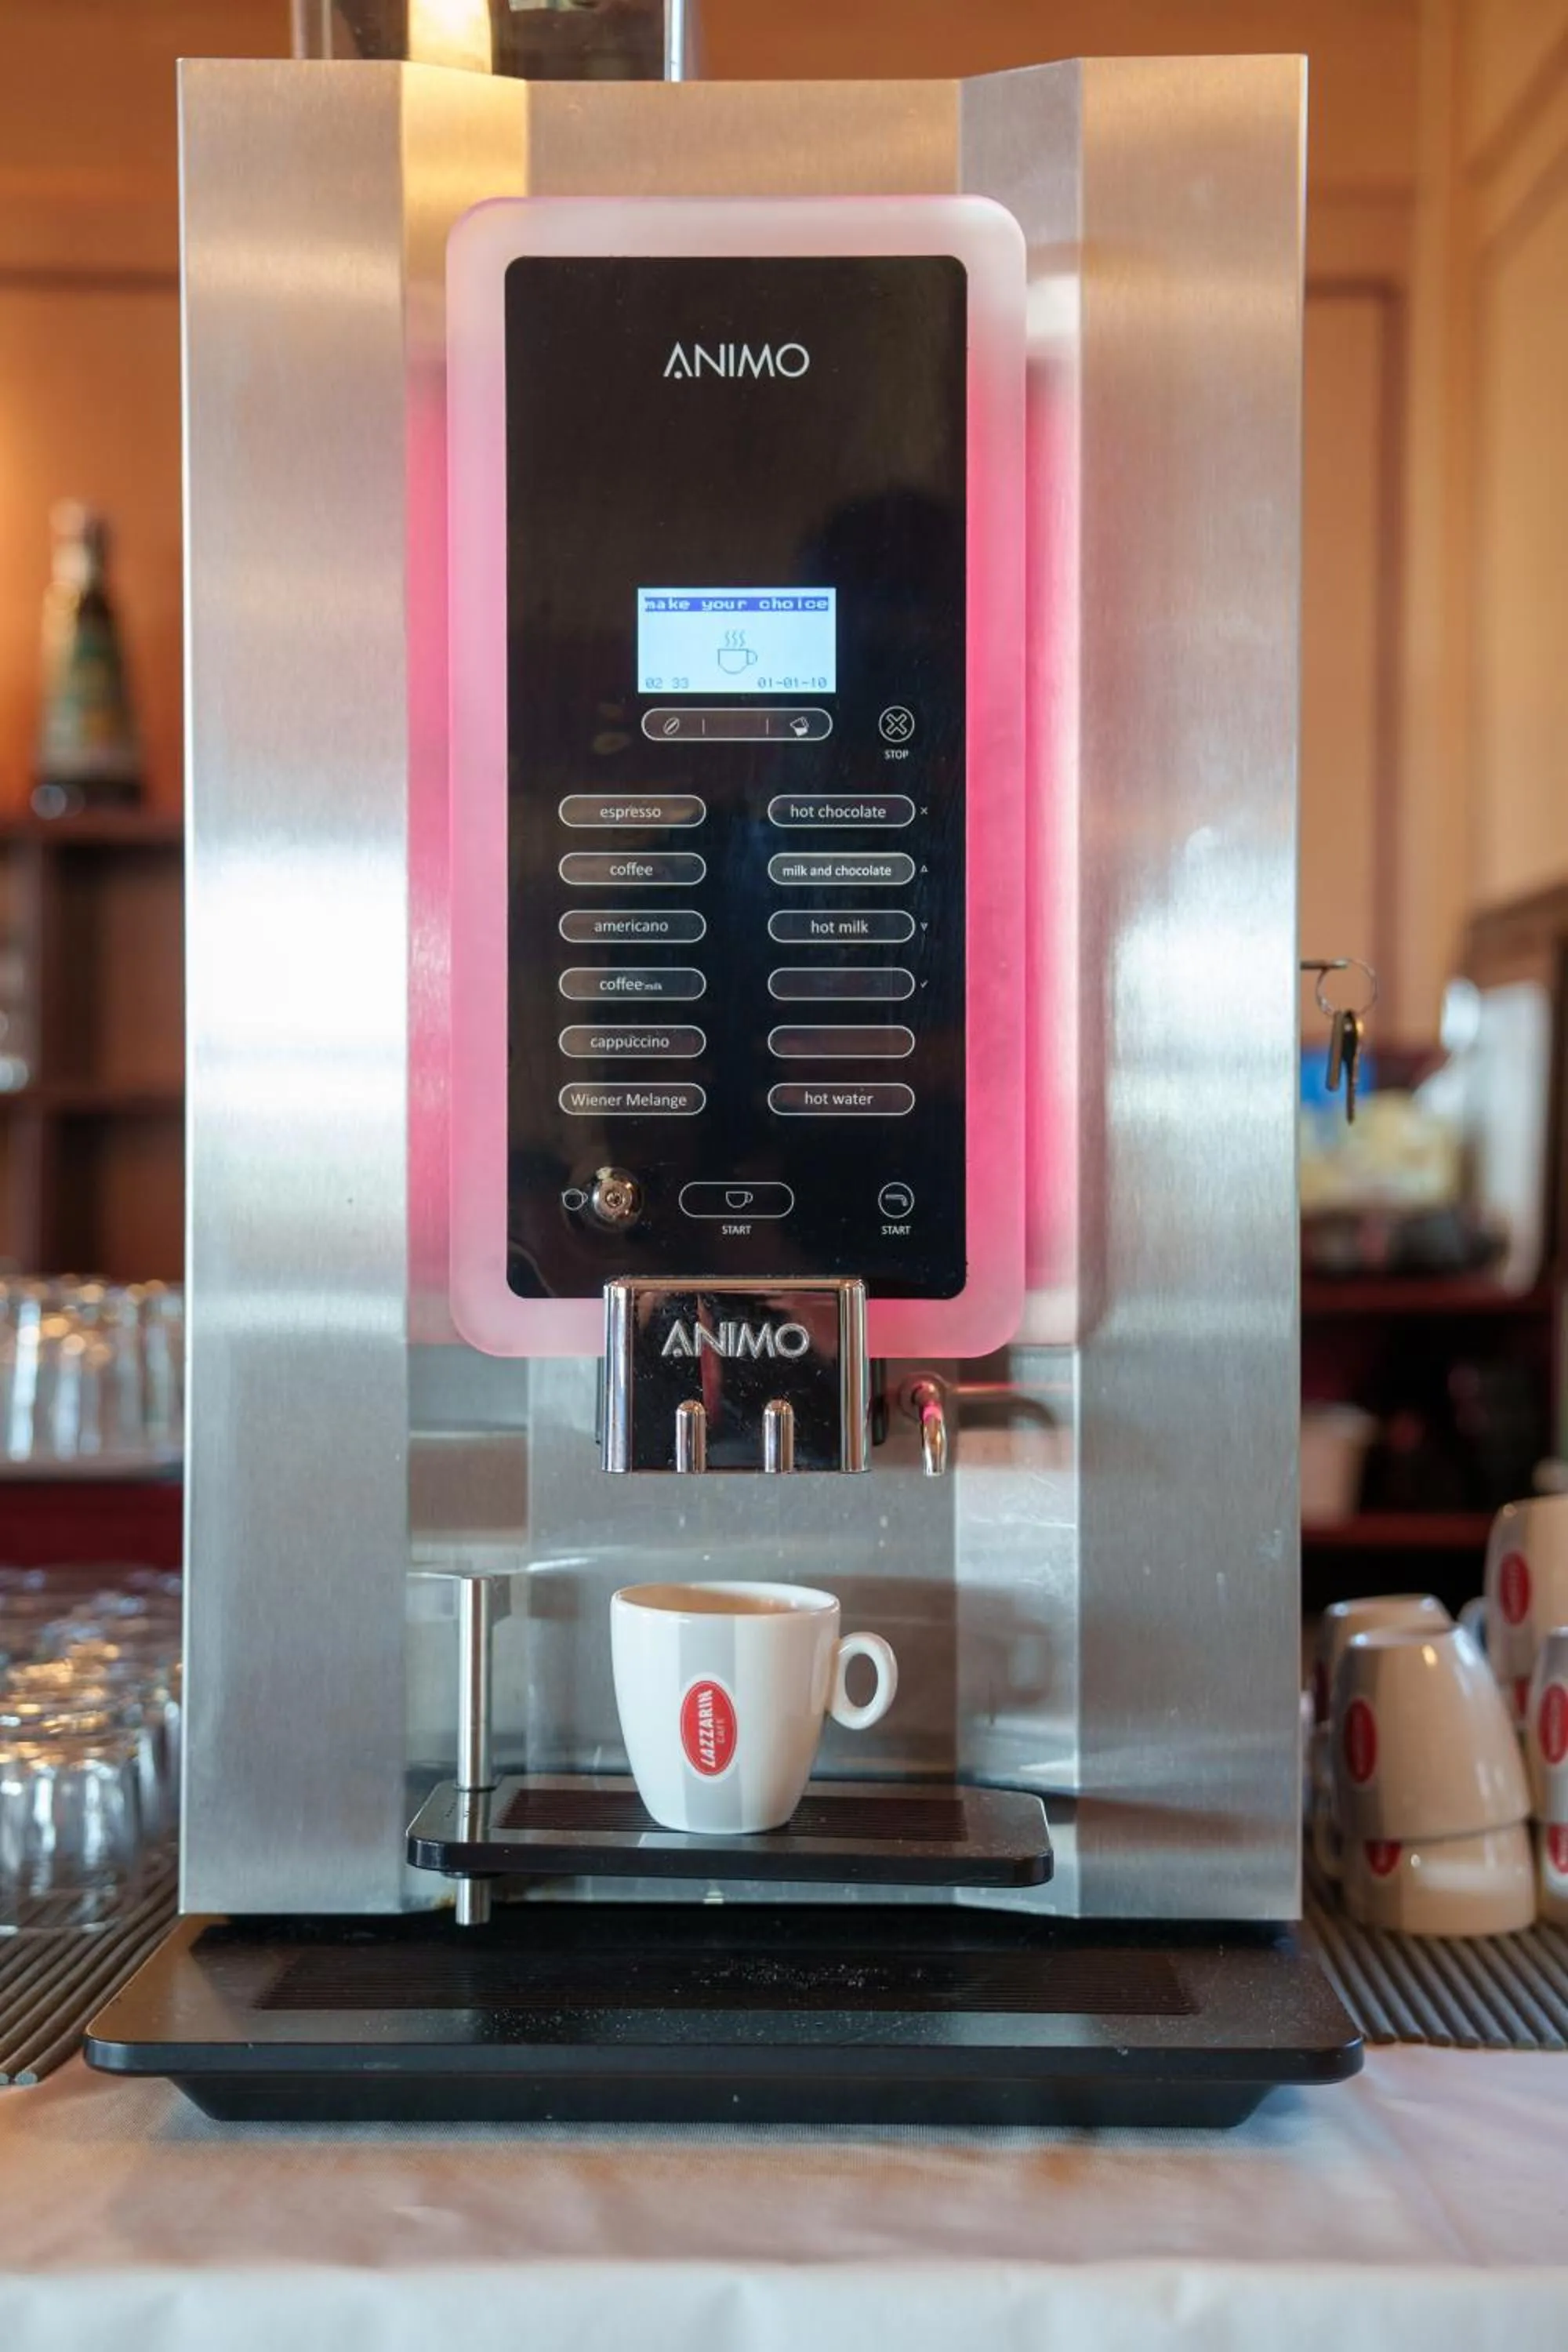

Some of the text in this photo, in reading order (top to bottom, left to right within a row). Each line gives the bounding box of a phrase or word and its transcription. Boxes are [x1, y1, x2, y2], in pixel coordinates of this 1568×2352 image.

[662, 341, 810, 379] ANIMO
[644, 597, 829, 612] make your choice
[645, 677, 690, 689] 02 33
[757, 677, 828, 689] 01-01-10
[884, 750, 909, 760] STOP
[599, 806, 662, 820] espresso
[790, 804, 887, 818] hot chocolate
[609, 862, 653, 876] coffee
[782, 865, 891, 877] milk and chocolate
[593, 919, 669, 932] americano
[811, 920, 869, 933] hot milk
[590, 1036, 670, 1051] cappuccino
[571, 1093, 687, 1109] Wiener Melange
[804, 1091, 873, 1105] hot water
[721, 1225, 752, 1236] START
[881, 1225, 912, 1236] START
[661, 1319, 810, 1359] ANIMO
[697, 1689, 716, 1768] LAZZARIN
